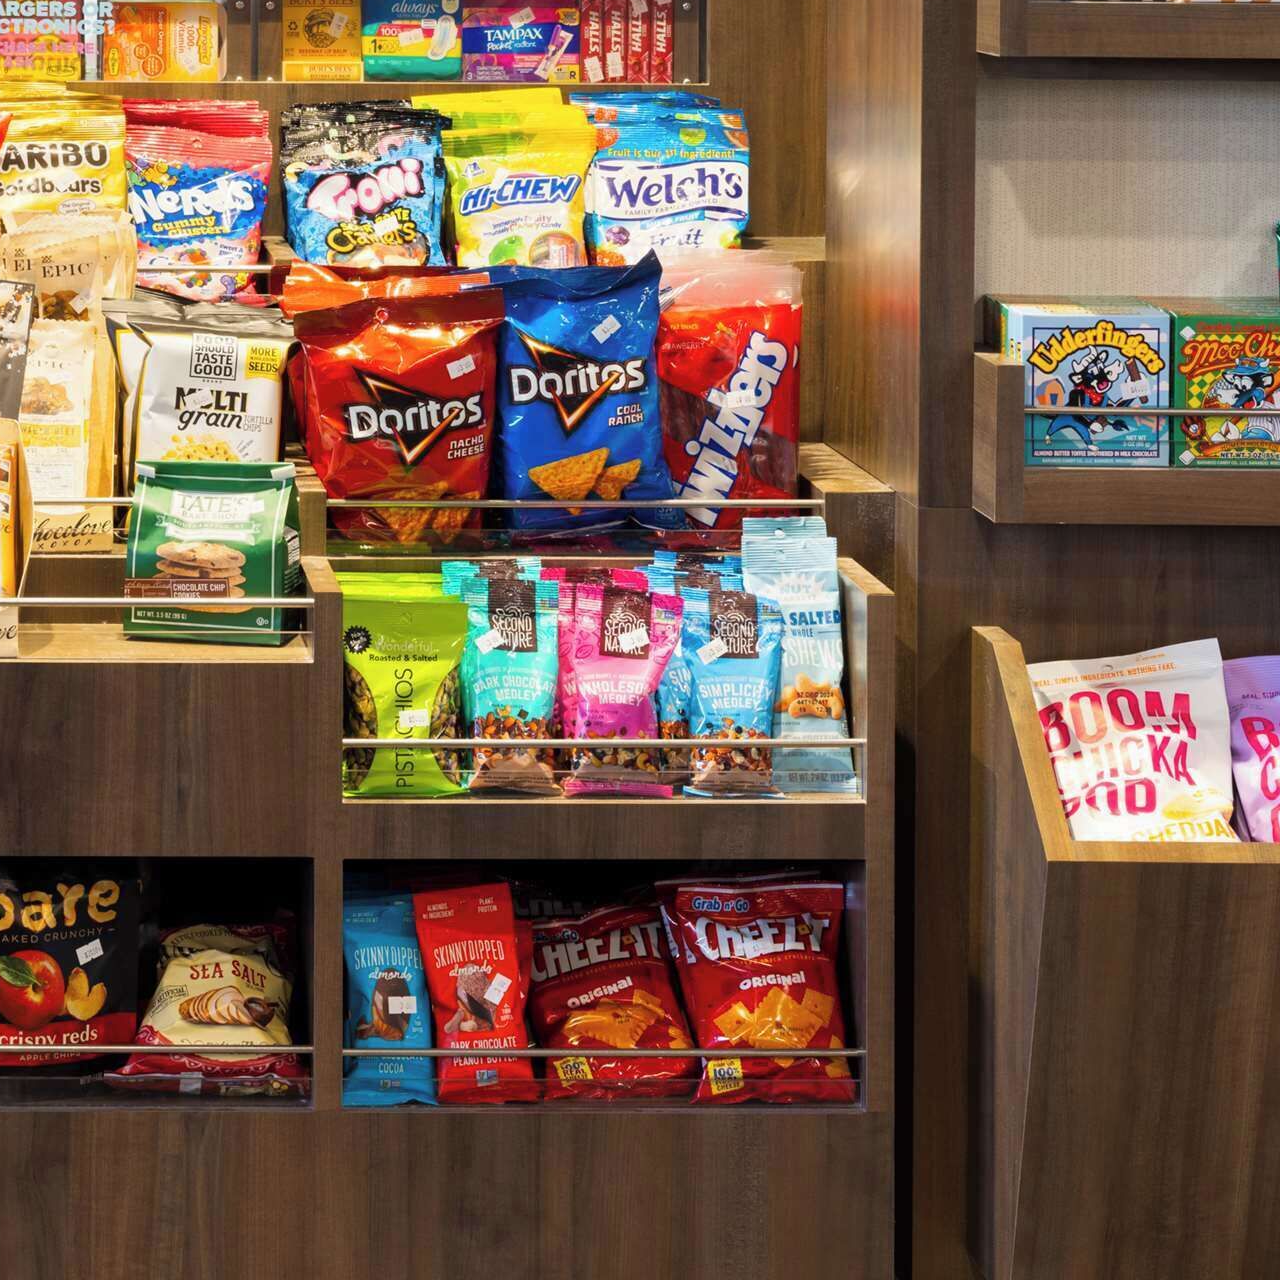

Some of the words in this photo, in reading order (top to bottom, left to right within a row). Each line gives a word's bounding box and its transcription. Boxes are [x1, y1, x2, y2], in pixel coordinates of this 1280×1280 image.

[82, 1, 113, 17] OR
[391, 0, 438, 18] always
[483, 27, 544, 42] TAMPAX
[589, 10, 600, 55] HALLS
[655, 9, 668, 53] HALLS
[607, 148, 632, 160] Fruit
[633, 148, 643, 159] is
[307, 157, 424, 221] Trolli
[605, 167, 745, 209] Welch's
[41, 261, 95, 280] EPIC
[250, 347, 277, 357] MORE
[1027, 319, 1167, 376] Udderfingers
[195, 353, 234, 366] TASTE
[248, 361, 279, 373] SEEDS
[193, 362, 233, 378] GOOD
[510, 359, 647, 403] Doritos
[348, 392, 485, 441] Doritos
[616, 403, 643, 417] COOL
[177, 409, 246, 432] grain
[607, 412, 645, 428] RANCH
[446, 442, 486, 461] CHEESE
[448, 434, 485, 451] NACHO
[172, 582, 209, 592] CHOCOLATE
[210, 583, 226, 592] CHIP
[491, 614, 533, 633] SECOND
[713, 619, 755, 639] SECOND
[43, 925, 105, 944] CRUNCHY
[433, 939, 506, 969] SKINNYDIPPED
[189, 961, 224, 981] SEA
[231, 959, 268, 988] SALT
[61, 1025, 99, 1044] reds
